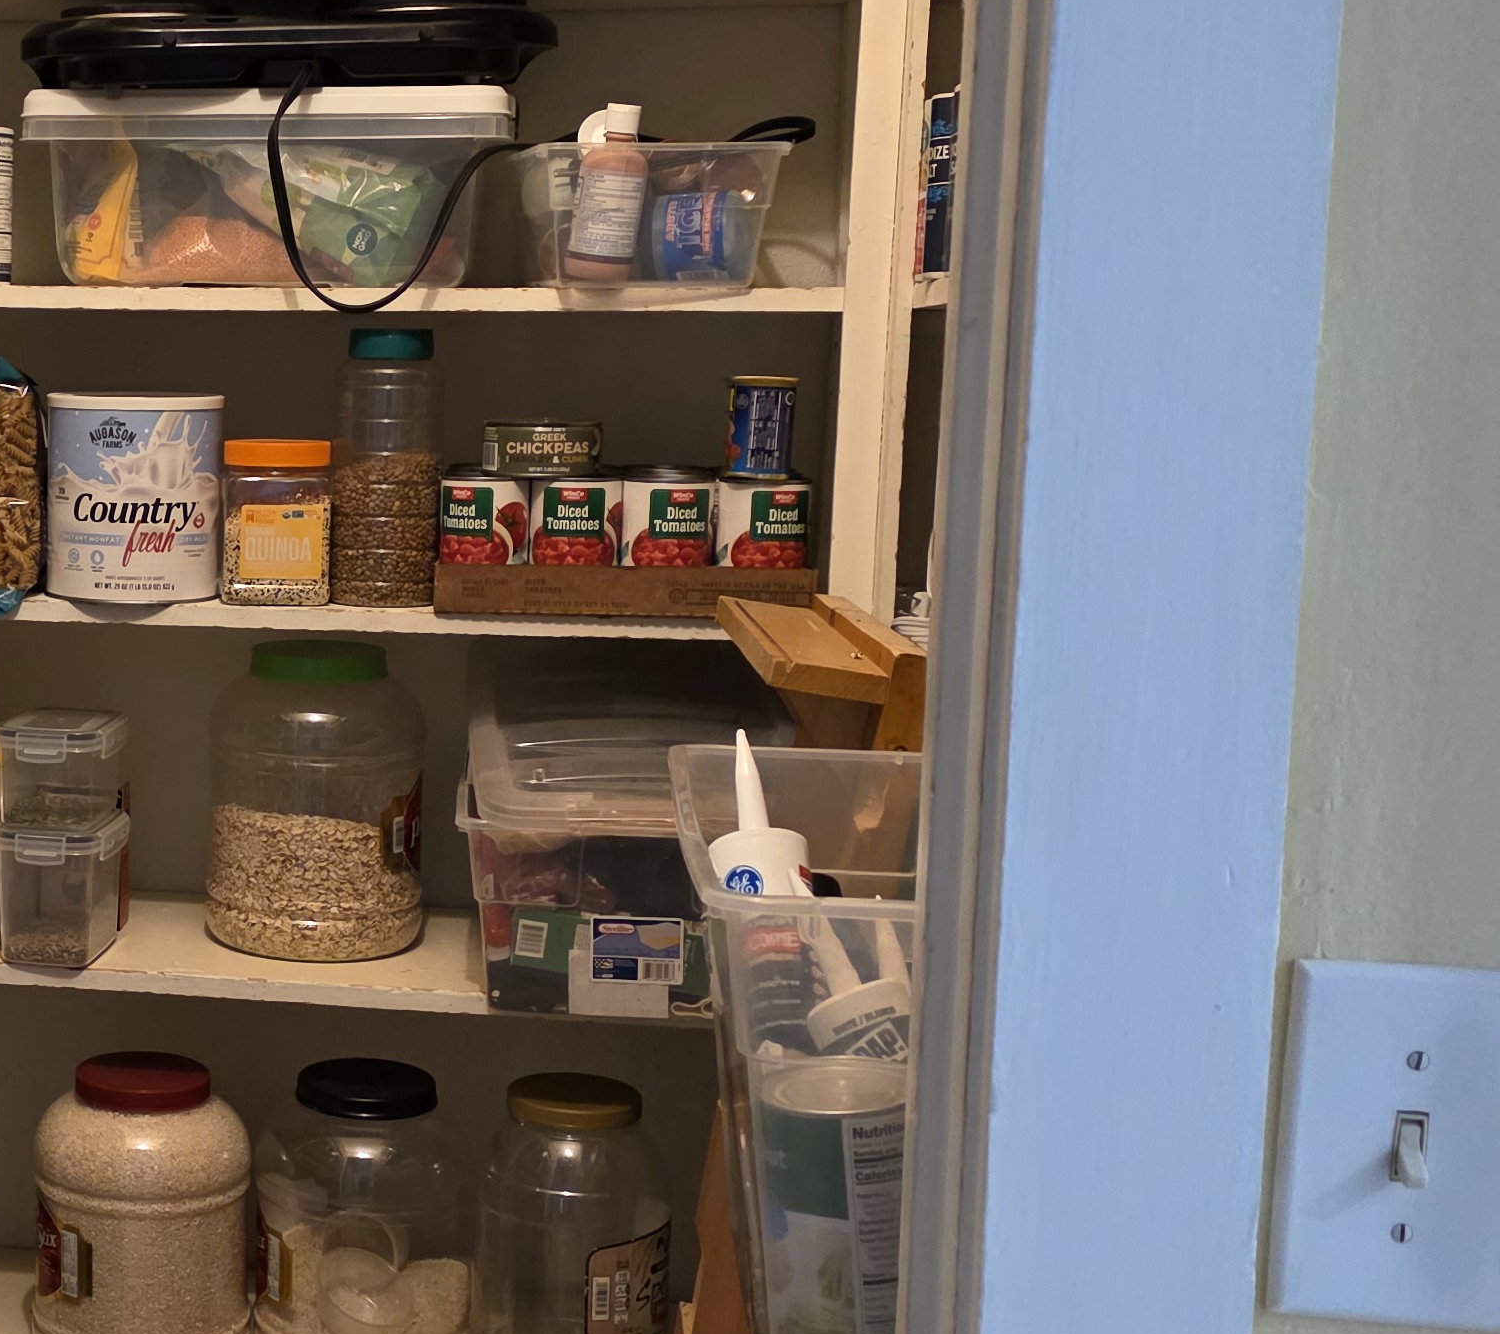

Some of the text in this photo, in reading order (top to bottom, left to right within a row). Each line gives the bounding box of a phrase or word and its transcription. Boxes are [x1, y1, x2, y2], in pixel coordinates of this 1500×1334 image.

[89, 427, 137, 445] AUGASON
[532, 432, 567, 442] GREEK
[102, 440, 123, 449] FARMS
[506, 441, 590, 455] CHICKPEAS
[552, 455, 560, 464] &
[563, 490, 585, 498] WinCo
[73, 493, 198, 532] Country
[449, 503, 476, 517] Diced
[557, 504, 589, 518] Diced
[666, 506, 698, 520] Diced
[768, 508, 799, 522] Diced
[443, 516, 488, 531] Tomatoes
[546, 517, 600, 532] Tomatoes
[654, 519, 706, 534] Tomatoes
[755, 521, 806, 536] Tomatoes
[89, 534, 121, 544] NONFAT
[122, 518, 176, 568] fresh
[244, 537, 313, 563] QUINOA
